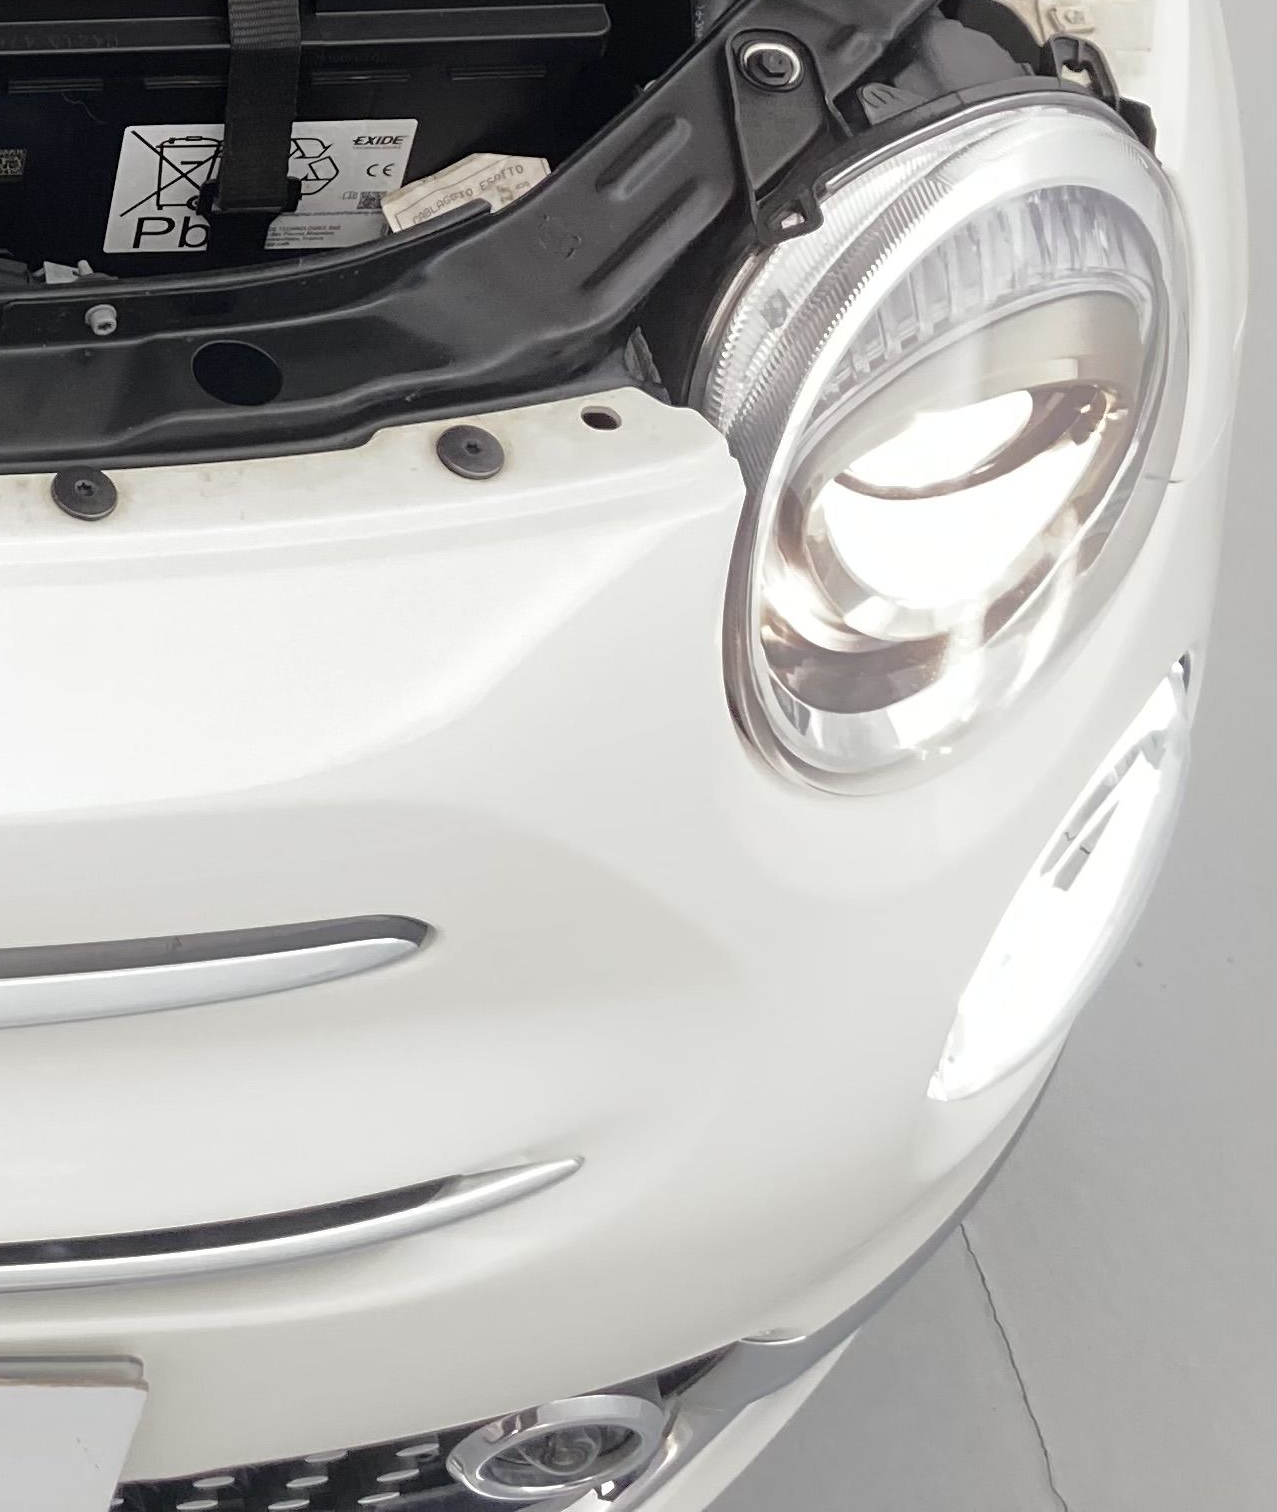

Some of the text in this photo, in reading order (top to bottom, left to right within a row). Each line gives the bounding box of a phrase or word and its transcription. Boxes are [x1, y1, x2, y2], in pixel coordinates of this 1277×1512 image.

[353, 135, 405, 145] EXIDE
[366, 163, 396, 177] CE
[132, 216, 210, 248] Pb
